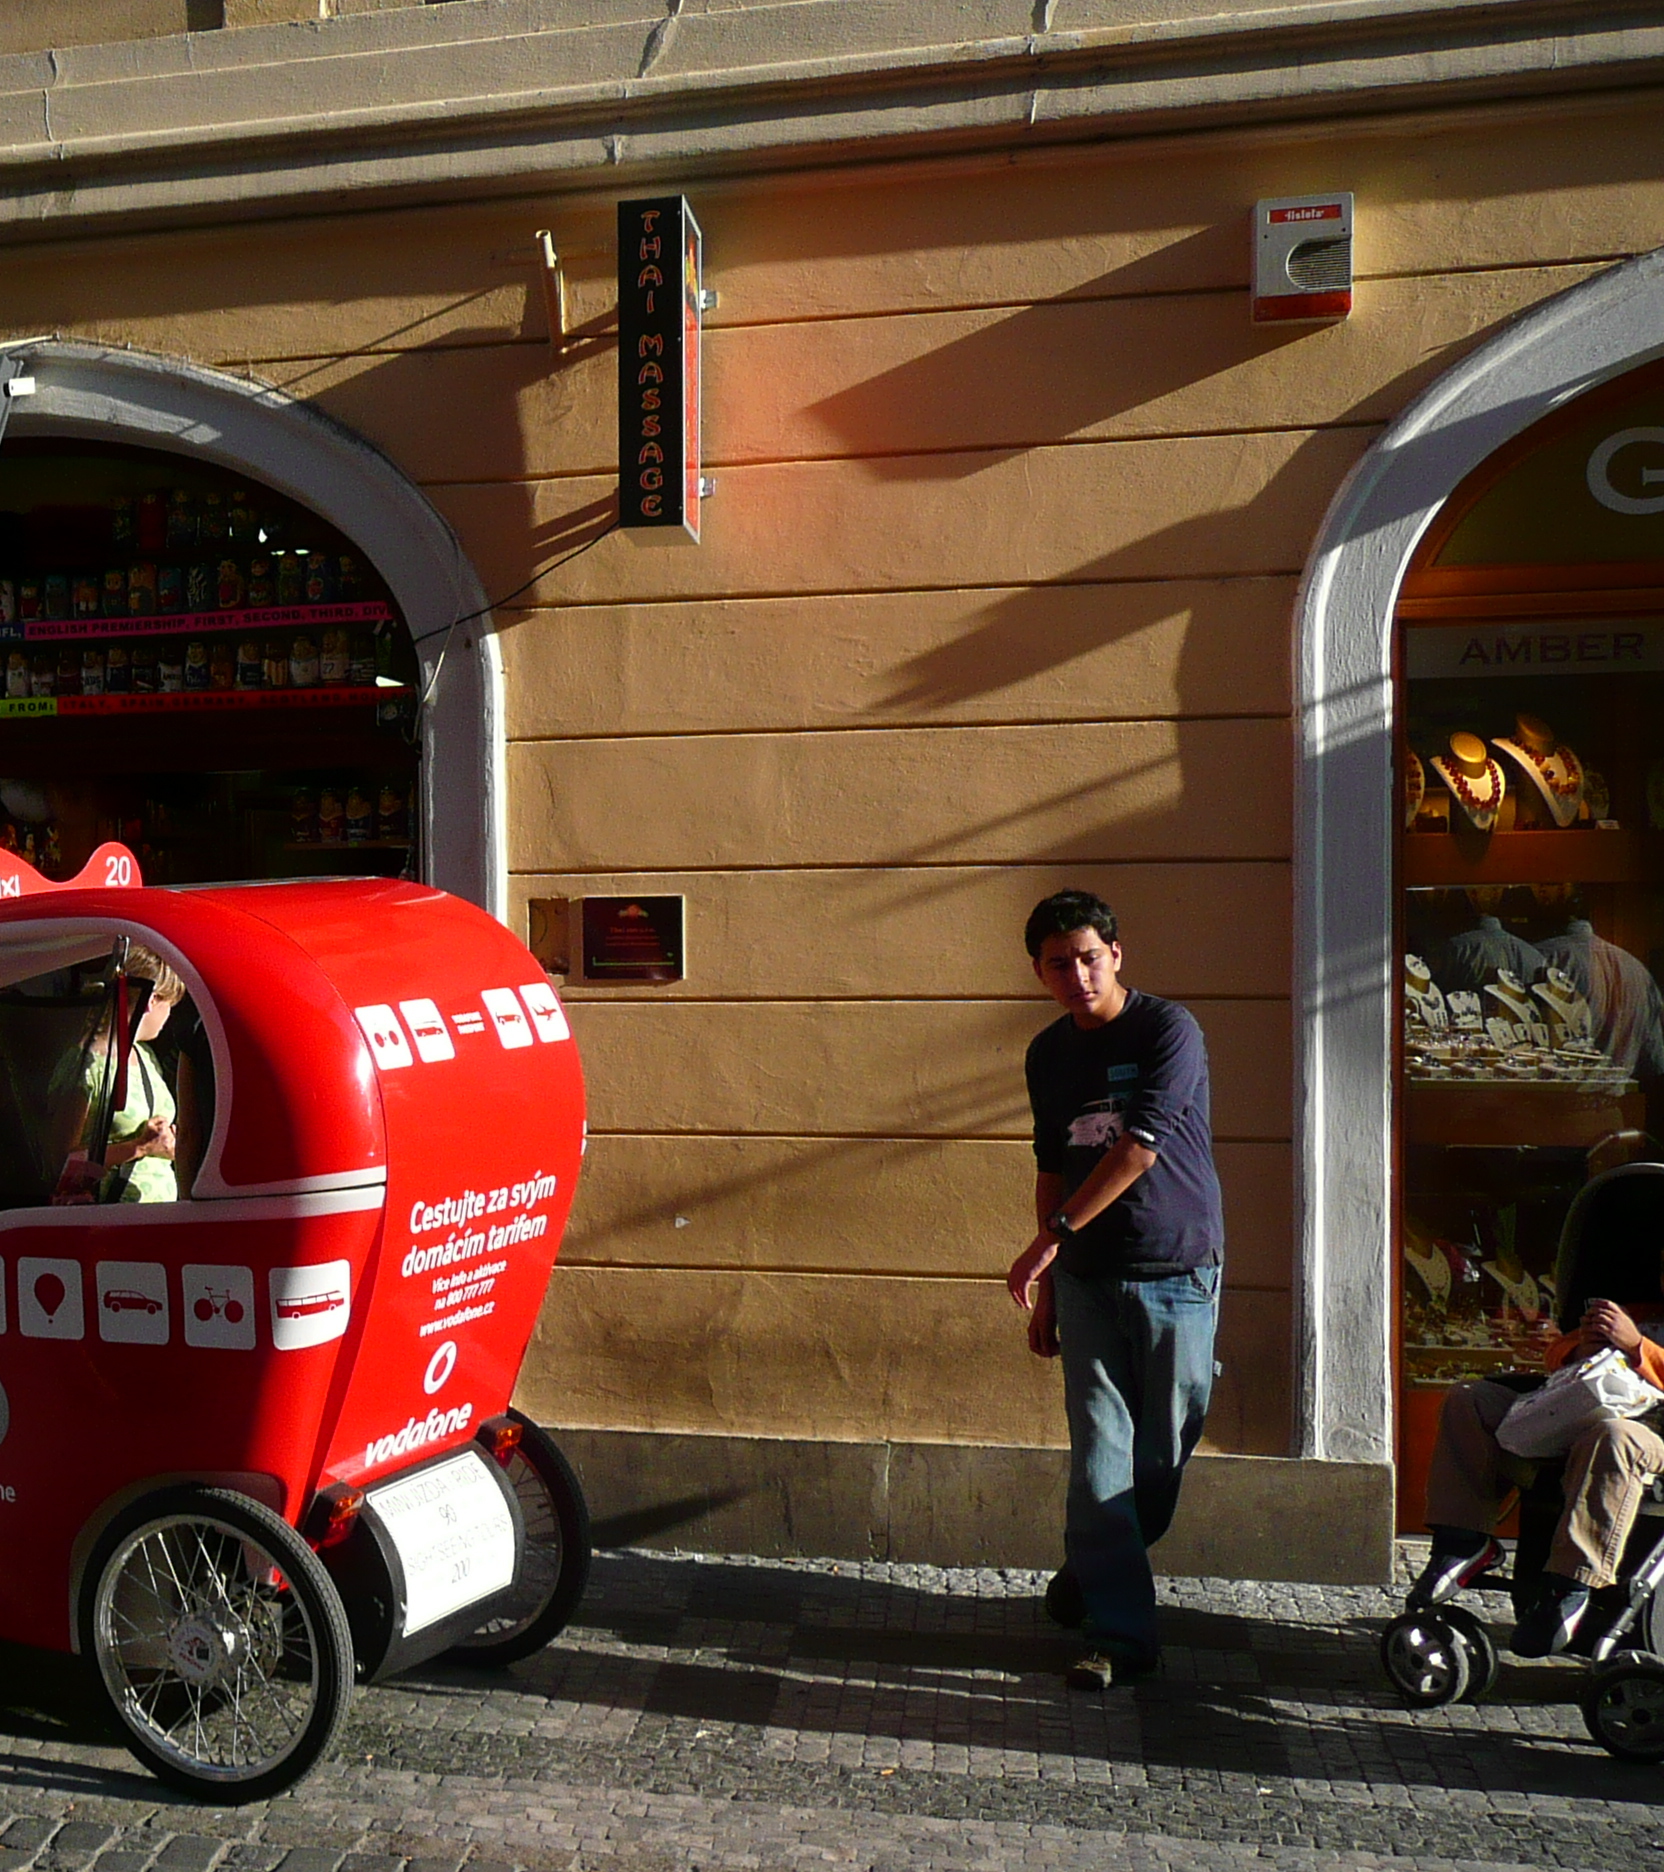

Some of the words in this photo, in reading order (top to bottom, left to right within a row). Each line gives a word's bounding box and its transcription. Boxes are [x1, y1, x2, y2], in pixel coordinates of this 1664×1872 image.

[636, 209, 664, 314] THAI
[637, 332, 664, 517] MASSAGE
[1459, 633, 1645, 665] AMBER
[104, 856, 132, 886] 20
[410, 1189, 485, 1234] Cestujte
[486, 1187, 509, 1213] za
[509, 1170, 557, 1210] svým
[401, 1227, 486, 1278] domácím
[486, 1213, 547, 1252] tarifem
[434, 1296, 447, 1310] na
[462, 1282, 478, 1302] 777
[477, 1278, 496, 1297] 777
[450, 1271, 466, 1288] info
[466, 1271, 474, 1283] a
[419, 1301, 496, 1337] www.vodafone.cz
[364, 1402, 473, 1468] vodafone
